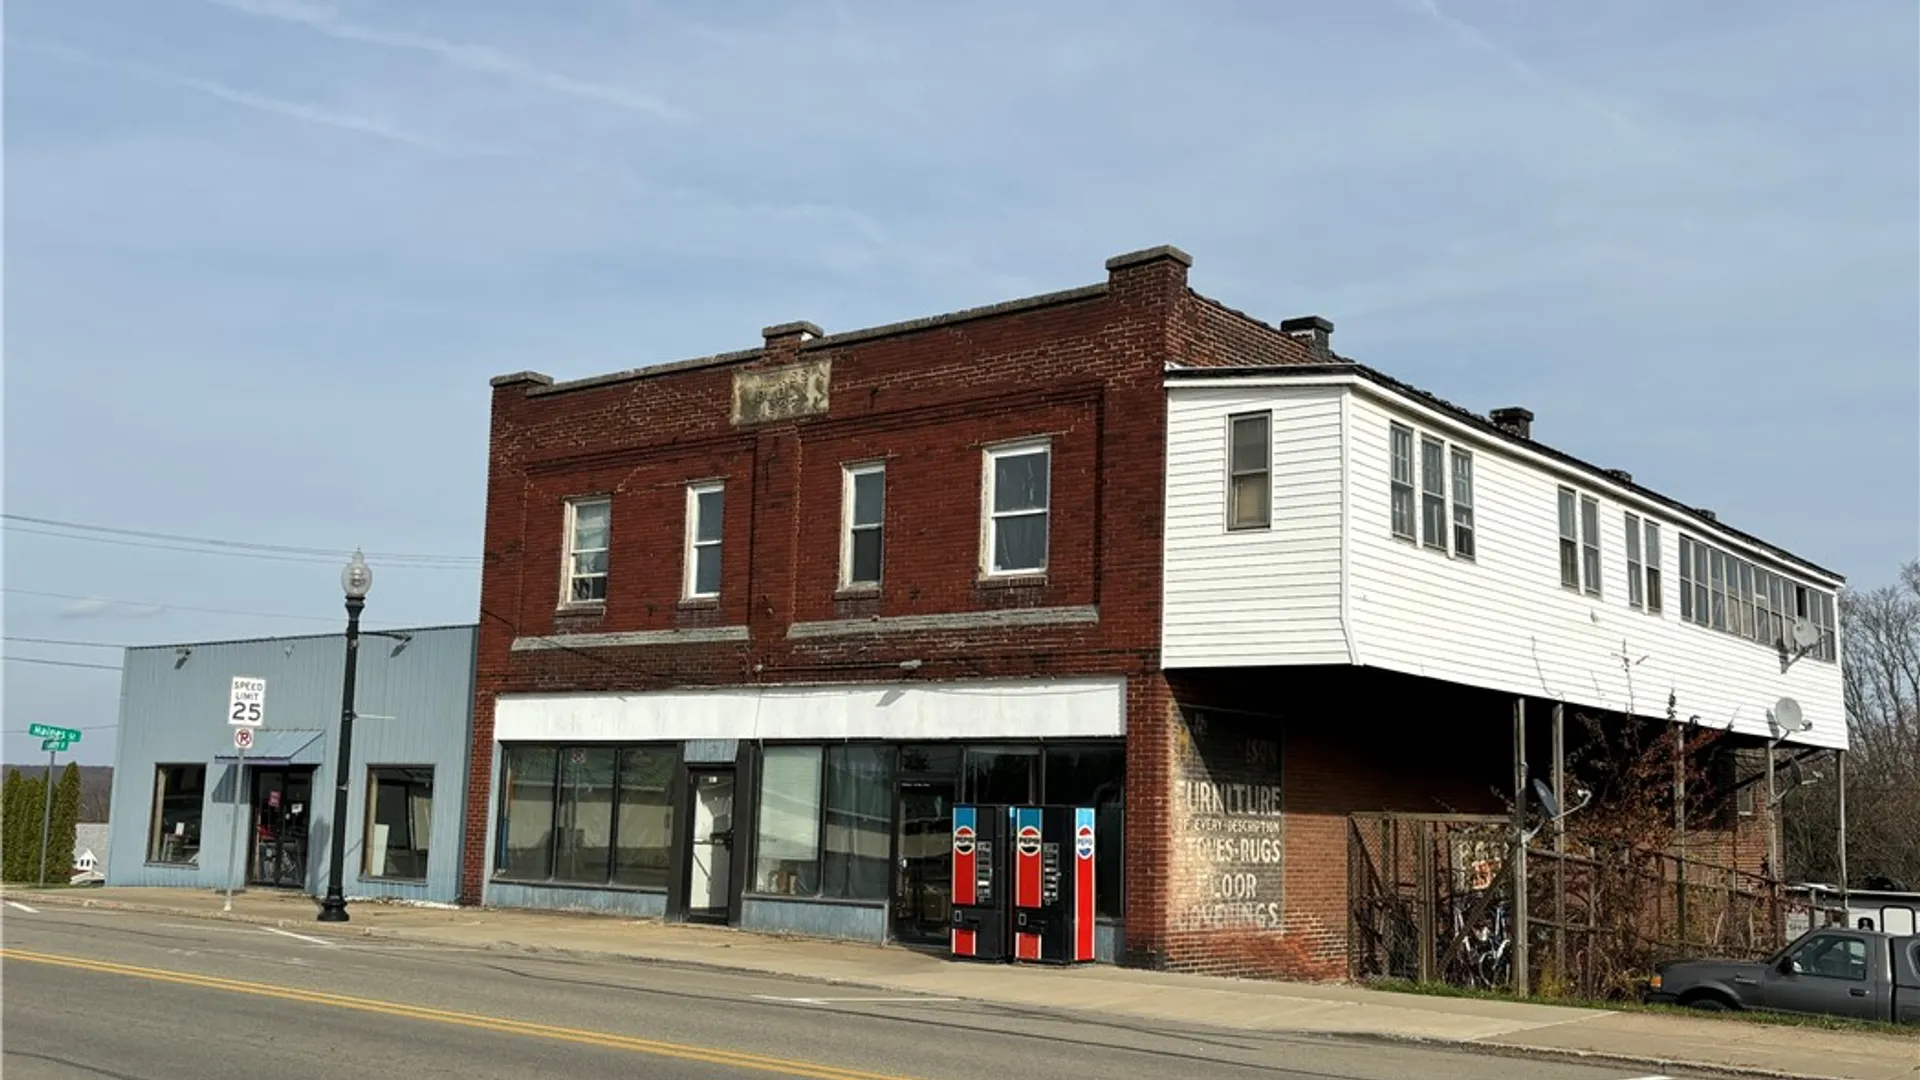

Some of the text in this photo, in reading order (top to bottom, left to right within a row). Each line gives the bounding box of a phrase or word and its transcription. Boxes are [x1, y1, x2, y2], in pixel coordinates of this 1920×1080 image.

[234, 681, 263, 691] SPEED
[235, 692, 259, 701] LIMIT
[232, 701, 261, 721] 25
[1174, 779, 1281, 816] FURNITURE
[955, 836, 974, 844] PEPSI
[1018, 836, 1040, 845] PEPSI
[1196, 872, 1257, 899] FLOOR
